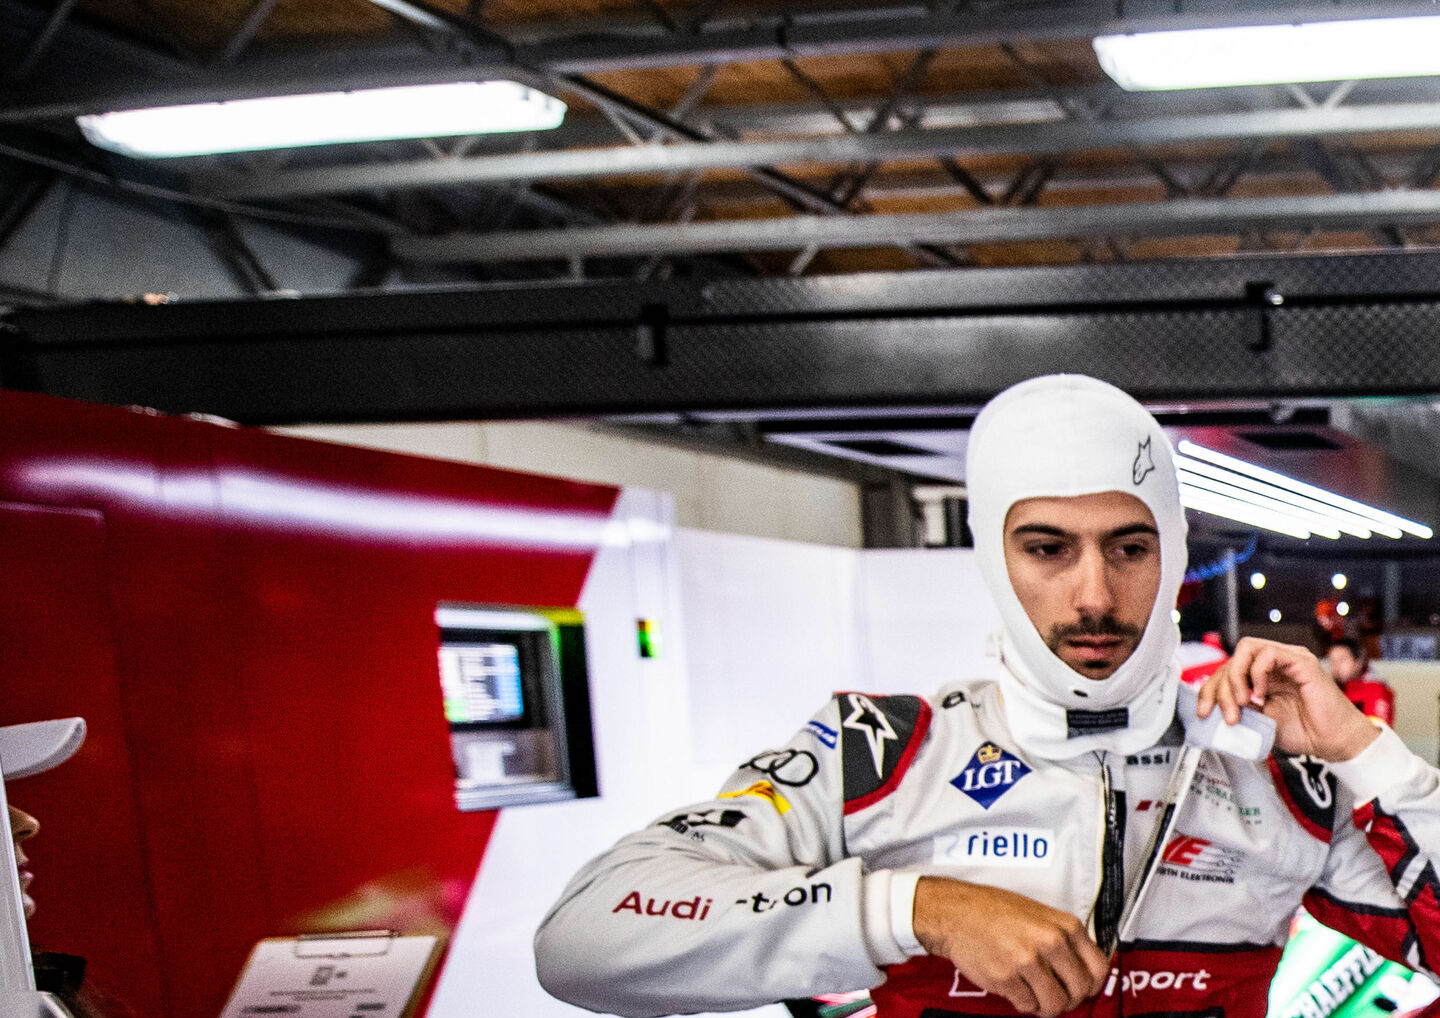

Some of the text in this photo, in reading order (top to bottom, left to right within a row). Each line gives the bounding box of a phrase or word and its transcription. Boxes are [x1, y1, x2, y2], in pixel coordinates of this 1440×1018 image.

[960, 759, 1022, 791] LGT
[967, 831, 1049, 859] riello
[1180, 870, 1235, 884] ELEKTRONIK
[611, 890, 714, 921] Audi
